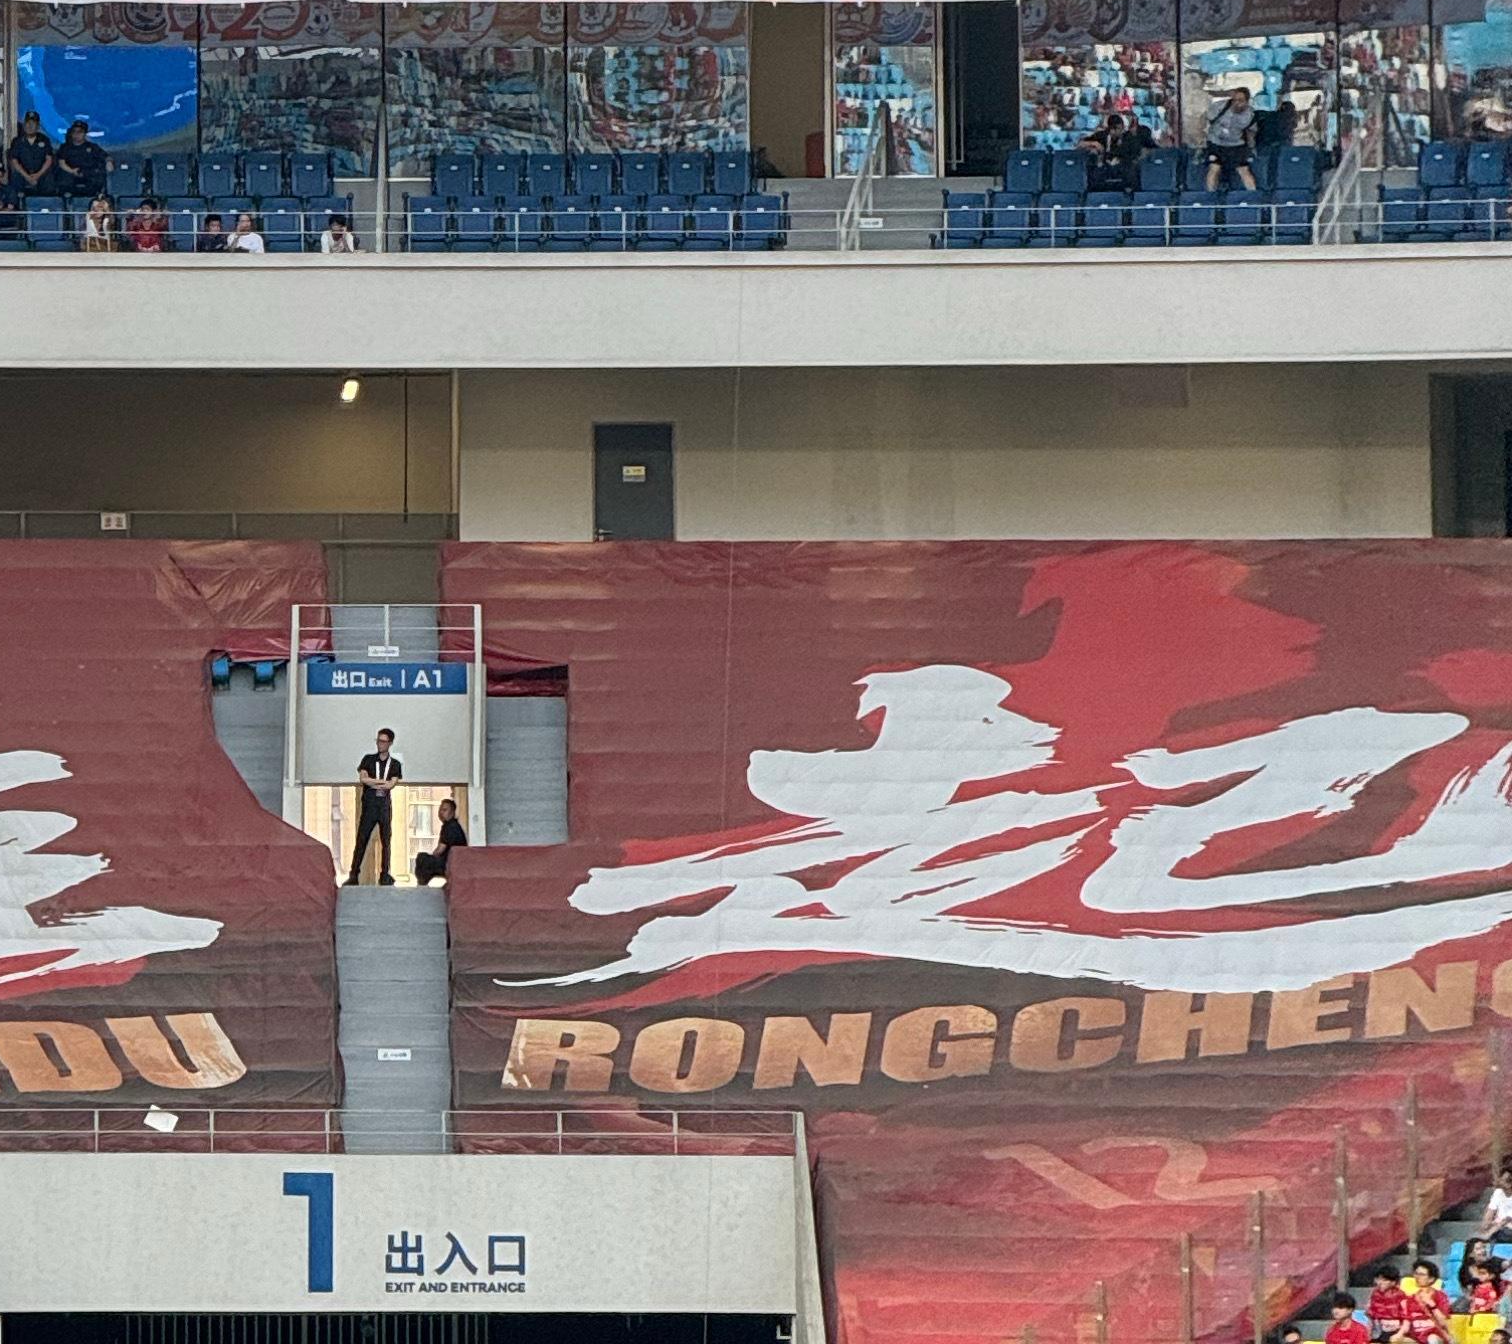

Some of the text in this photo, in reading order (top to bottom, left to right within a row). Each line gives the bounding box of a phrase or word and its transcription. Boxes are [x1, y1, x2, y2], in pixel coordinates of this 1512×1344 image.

[331, 668, 442, 689] 出口 Exit A1
[501, 959, 1512, 1093] RONGCHEN
[283, 1172, 334, 1293] 1
[385, 1230, 526, 1277] 出入口
[385, 1281, 526, 1294] EXIT AND ENTRANCE
